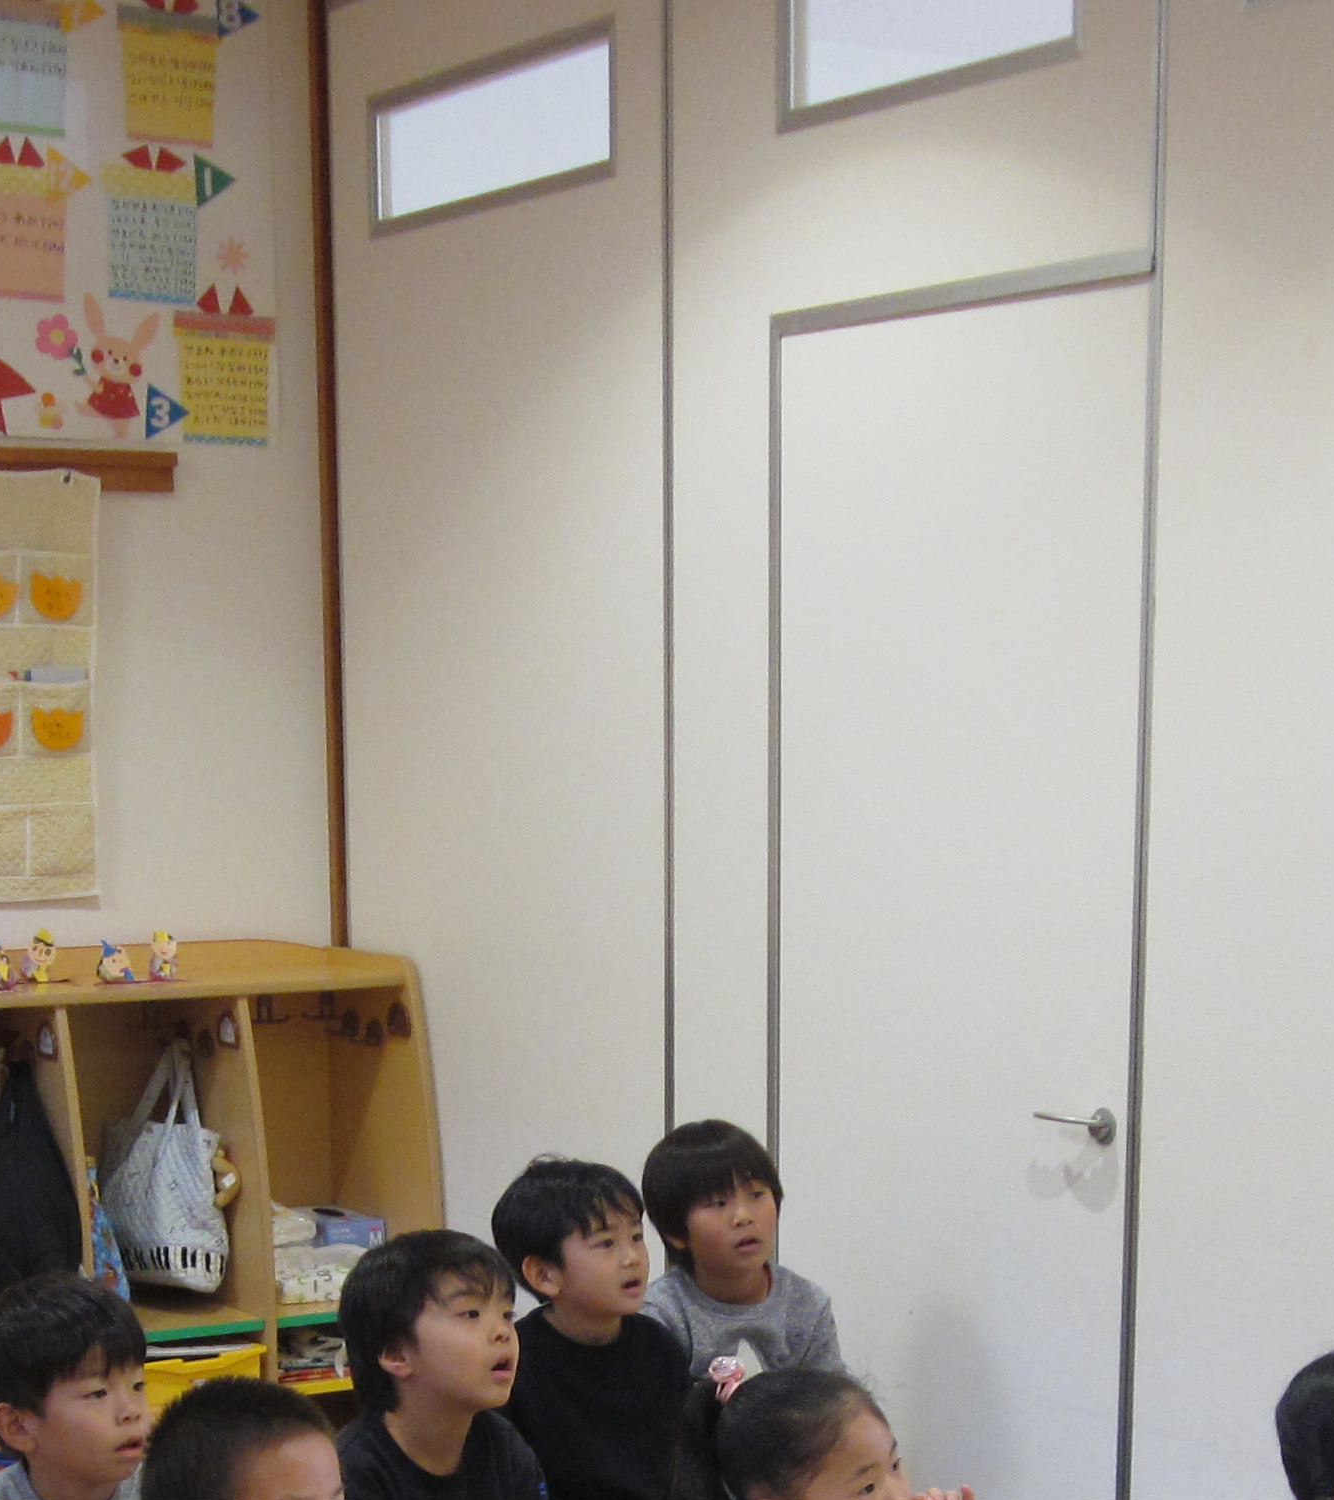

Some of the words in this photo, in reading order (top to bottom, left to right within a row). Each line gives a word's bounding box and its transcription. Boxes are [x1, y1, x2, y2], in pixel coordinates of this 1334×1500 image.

[51, 162, 74, 192] 12
[204, 167, 213, 197] 1
[150, 397, 171, 428] 3
